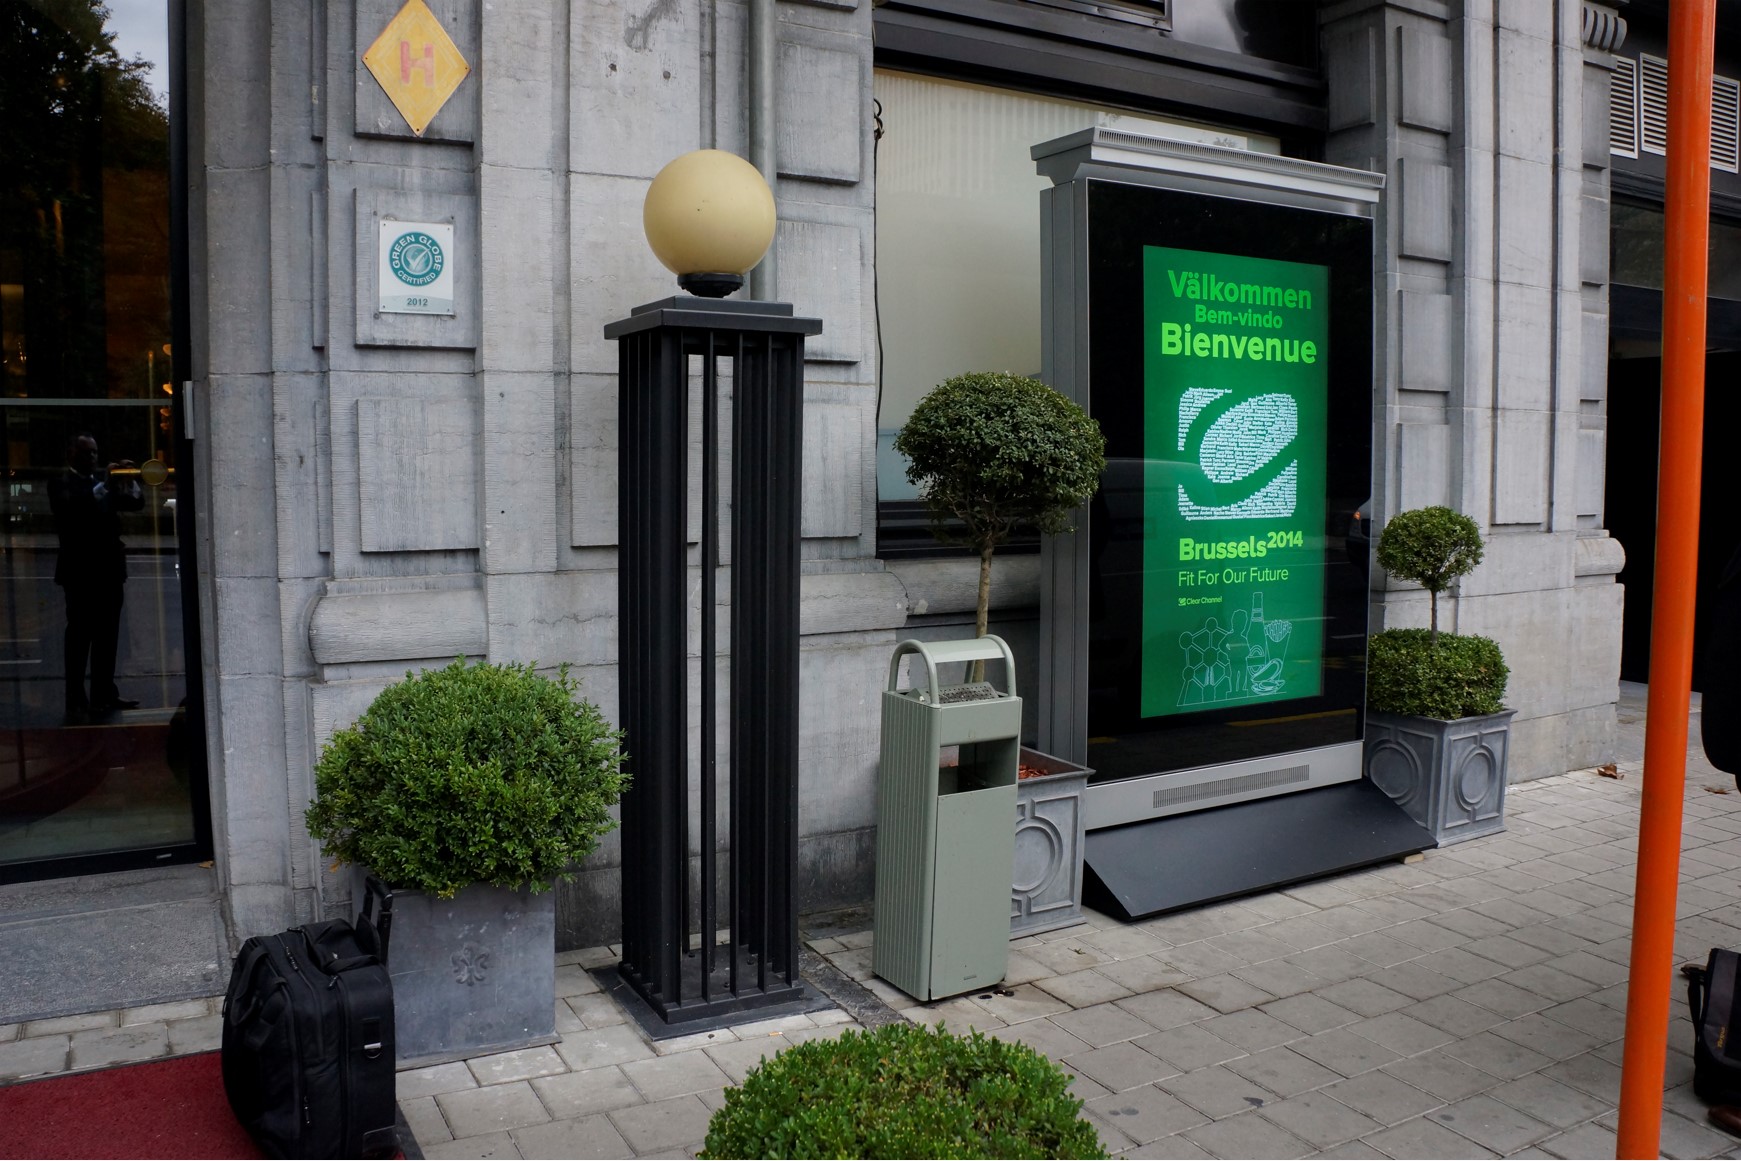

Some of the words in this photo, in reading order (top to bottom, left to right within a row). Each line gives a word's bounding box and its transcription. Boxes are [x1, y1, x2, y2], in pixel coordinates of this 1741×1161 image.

[400, 40, 434, 87] H
[392, 234, 415, 269] GREEN
[418, 235, 442, 272] GLOBE
[397, 270, 436, 285] CERTIFIED
[1167, 269, 1312, 310] Välkommen
[406, 297, 428, 306] 2012
[1195, 304, 1283, 329] Bem-vindo
[1161, 322, 1317, 364] Bienvenue
[1178, 571, 1194, 587] Fit
[1198, 570, 1219, 585] For
[1222, 568, 1247, 584] Our
[1250, 567, 1289, 583] Future
